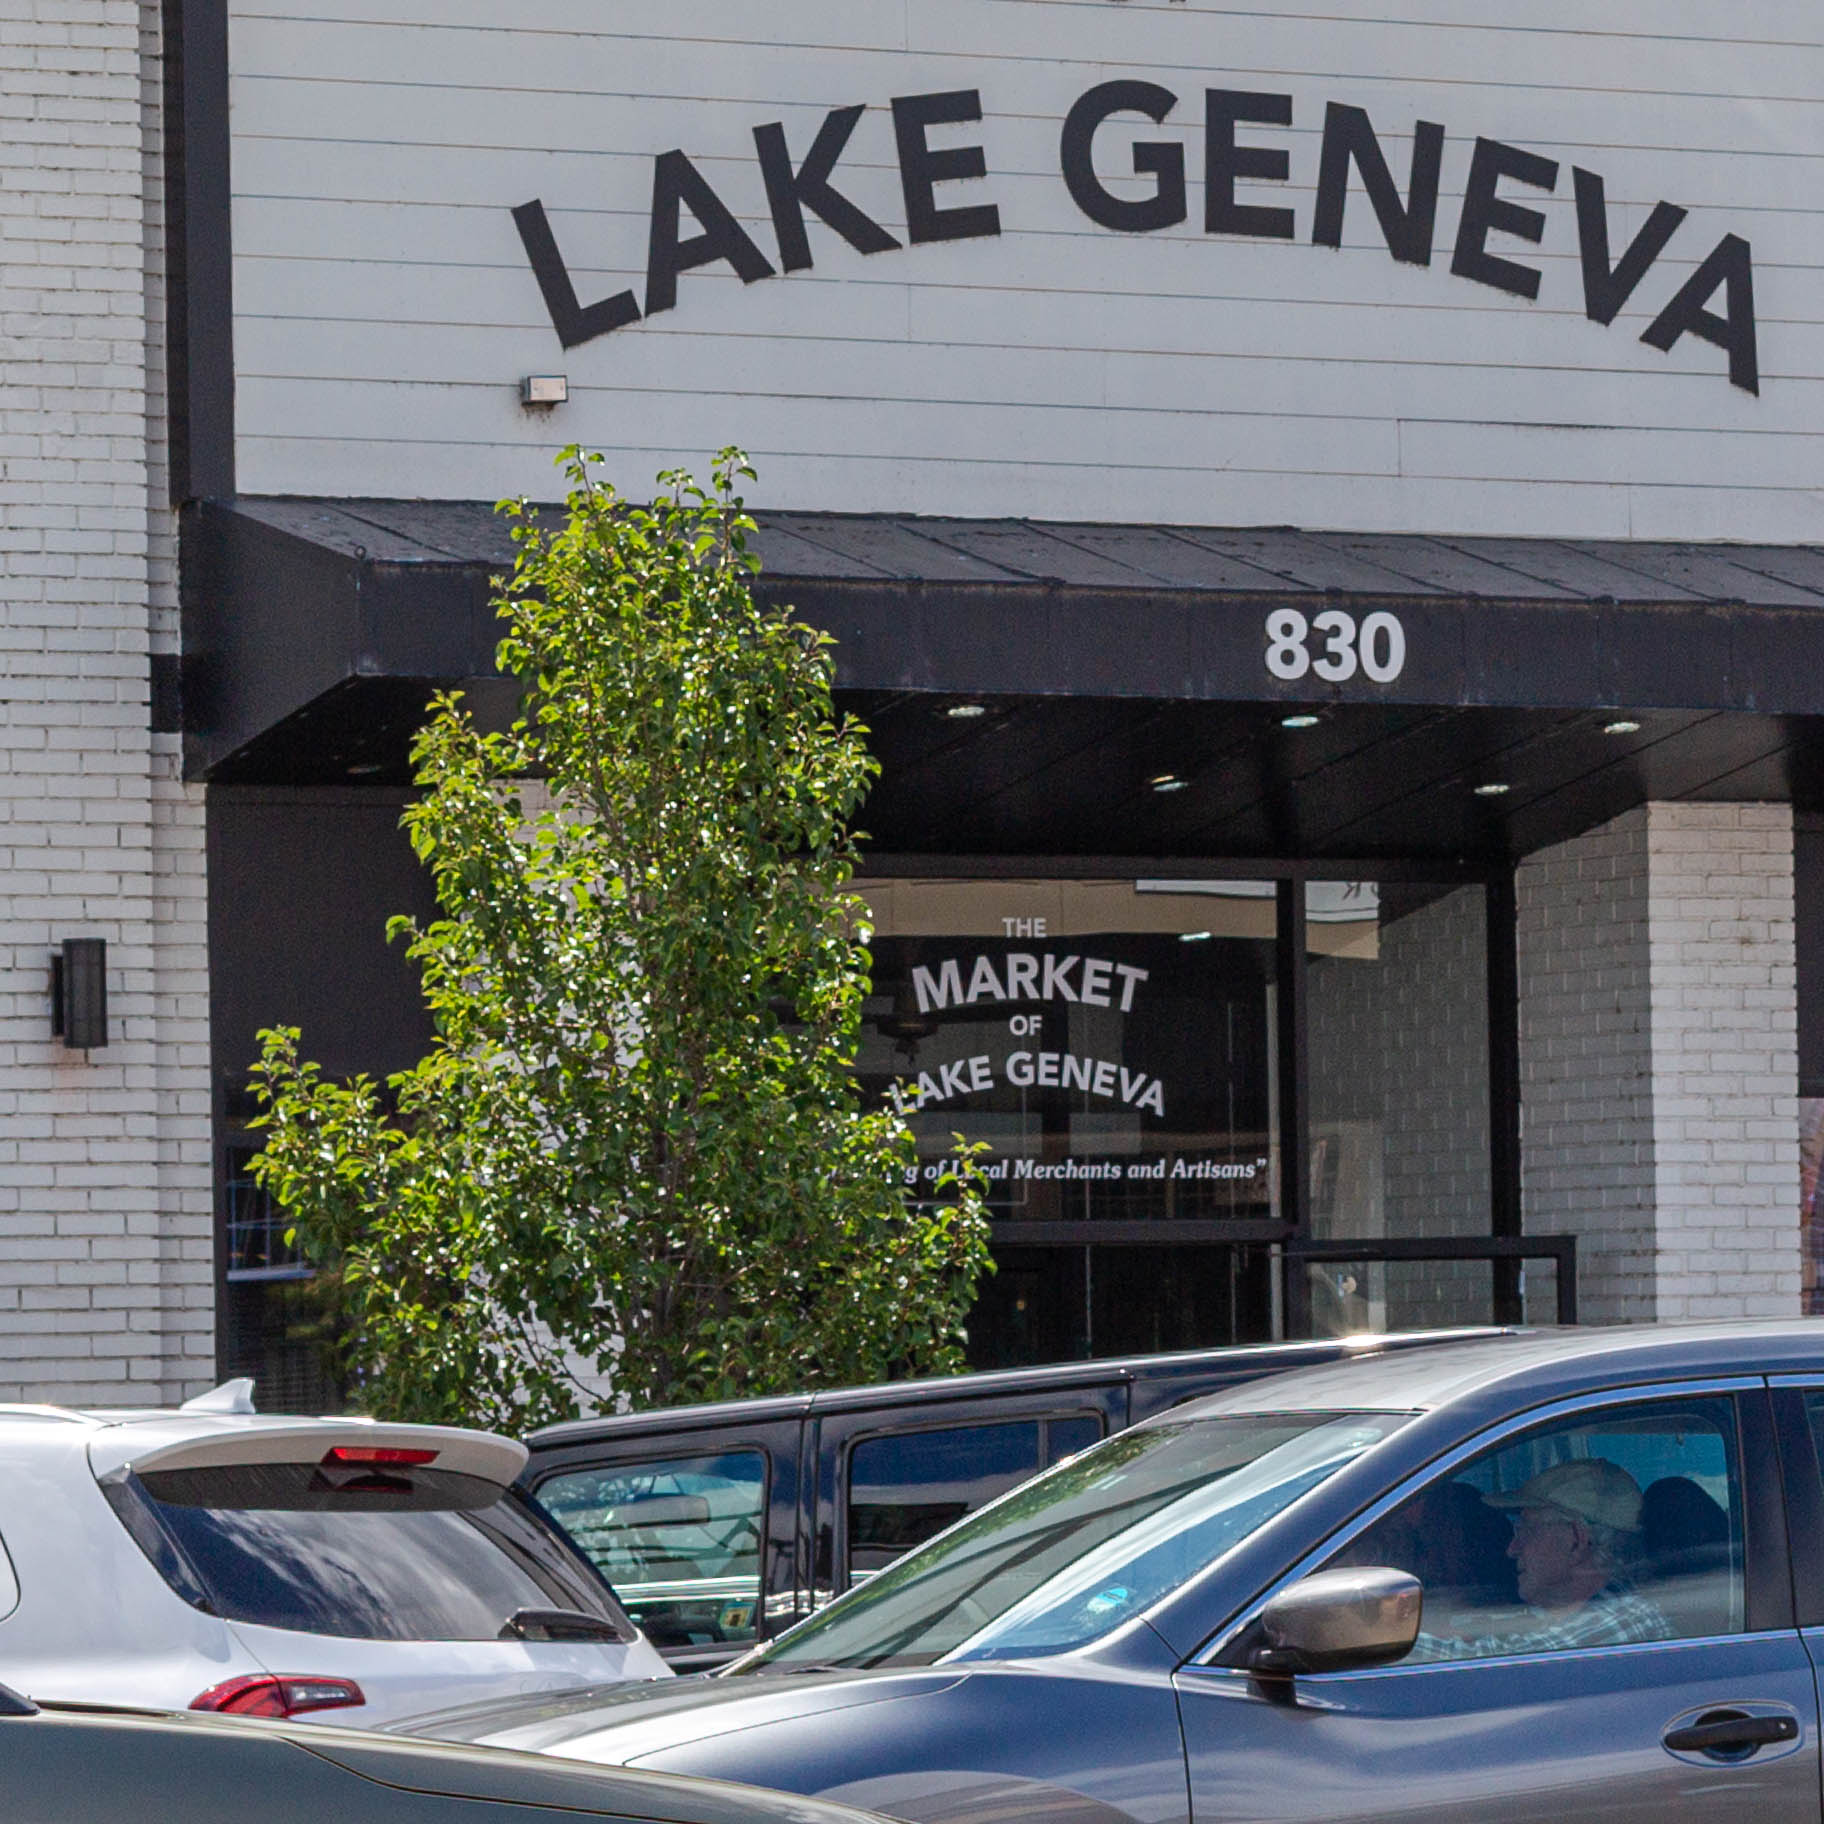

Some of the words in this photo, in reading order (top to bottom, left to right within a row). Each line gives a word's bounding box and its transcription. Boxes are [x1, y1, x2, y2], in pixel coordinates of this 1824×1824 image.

[512, 89, 1002, 350] LAKE
[1060, 79, 1760, 397] GENEVA
[1265, 608, 1406, 683] 830
[1002, 917, 1047, 938] THE
[911, 952, 1149, 1014] MARKET
[1009, 1014, 1043, 1036] OF
[888, 1055, 994, 1116] LAKE
[1006, 1050, 1165, 1117] GENEVA
[923, 1158, 945, 1179] of
[1013, 1160, 1121, 1180] Merchants
[1127, 1159, 1166, 1180] and
[1170, 1156, 1267, 1180] Artisans”
